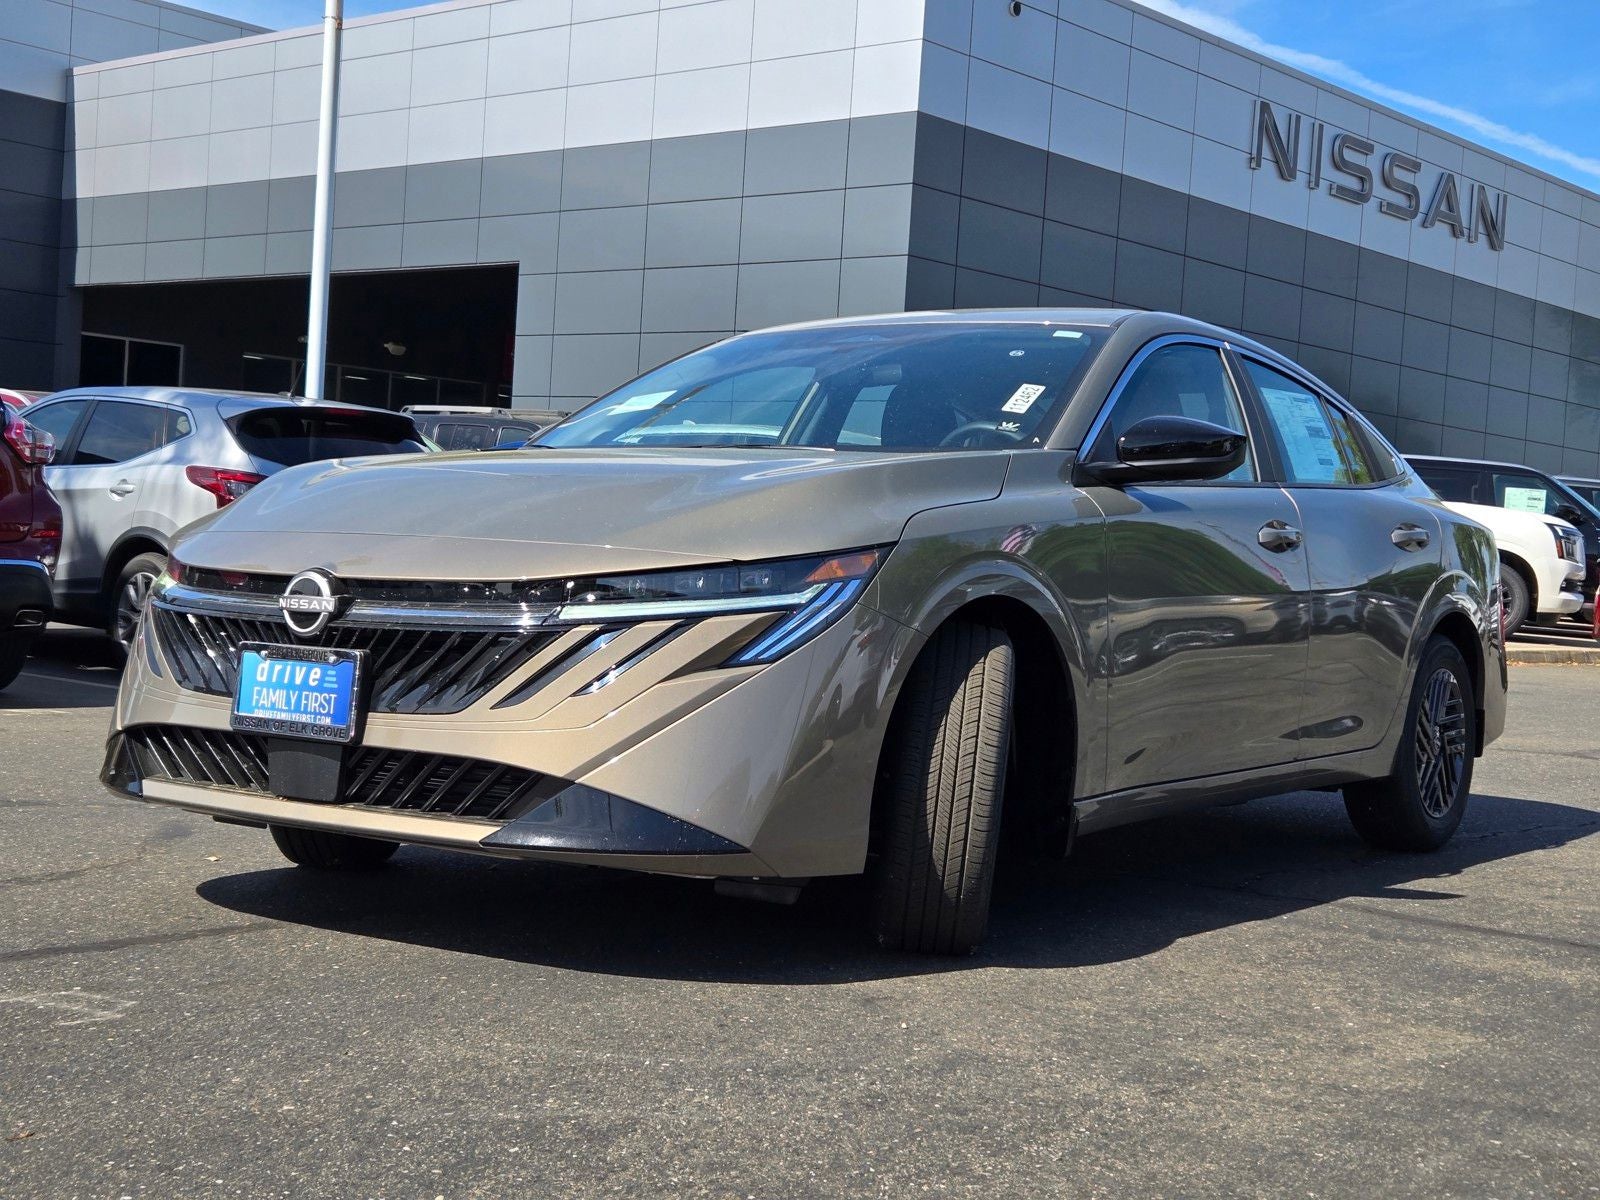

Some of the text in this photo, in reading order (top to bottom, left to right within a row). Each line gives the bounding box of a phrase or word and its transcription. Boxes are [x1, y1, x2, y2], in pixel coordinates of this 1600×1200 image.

[1249, 99, 1508, 252] NISSAN
[279, 597, 333, 611] NISSAN
[256, 659, 321, 686] drive
[252, 686, 337, 715] FAMILY FIRST
[234, 715, 346, 739] NISSAN OF ELK GROVE
